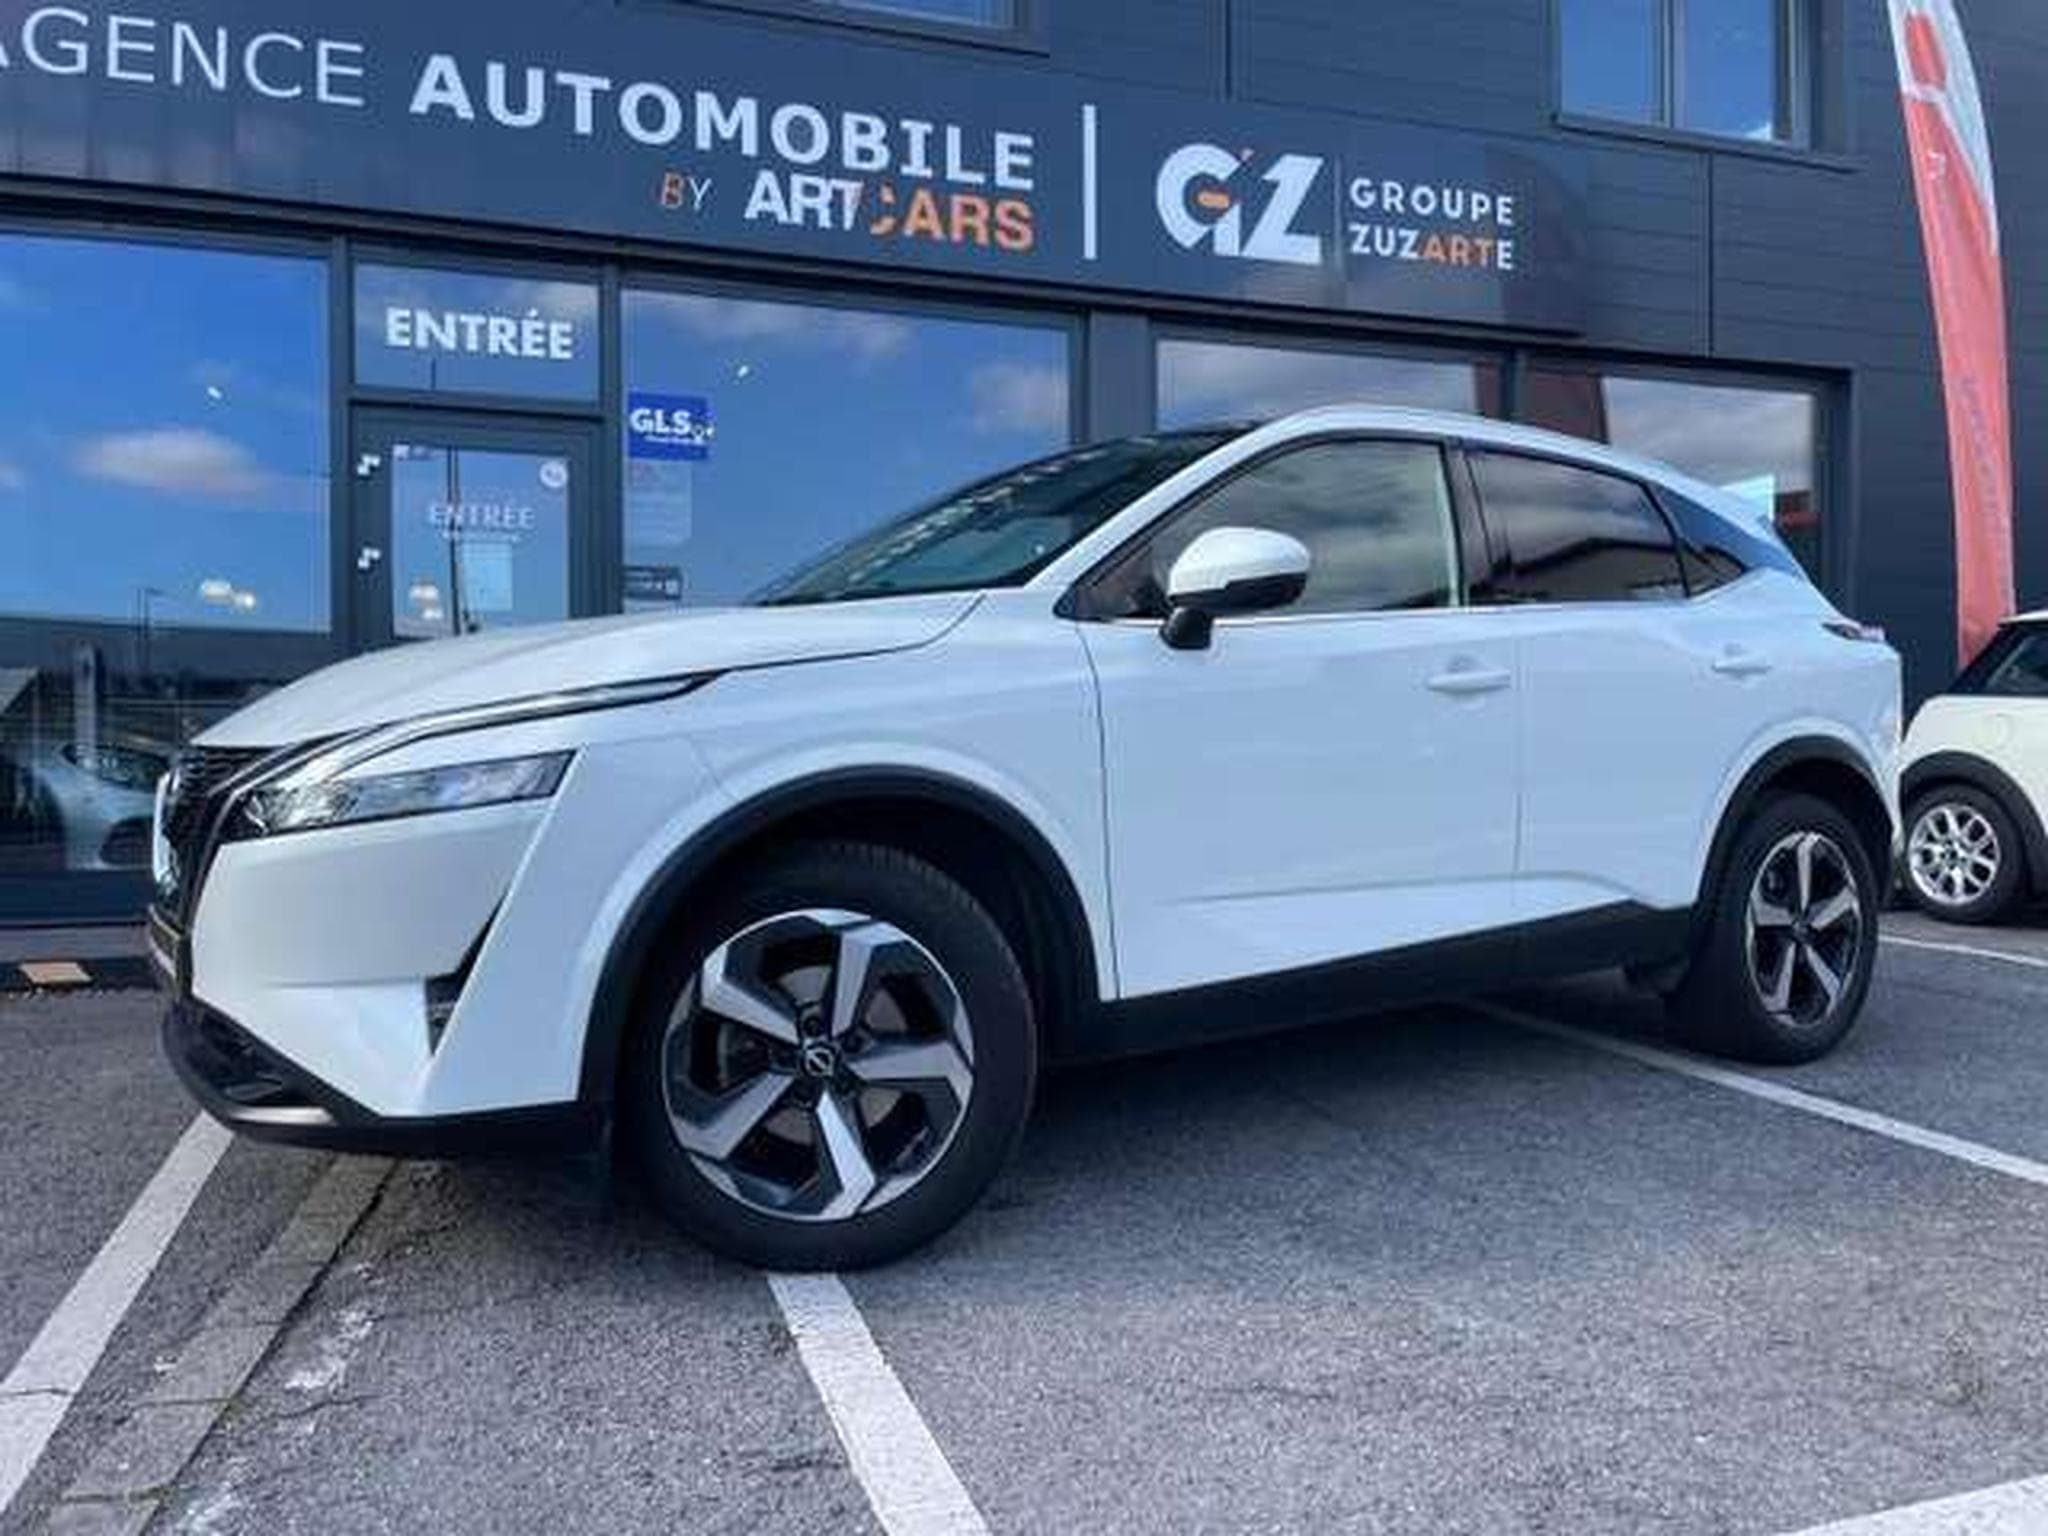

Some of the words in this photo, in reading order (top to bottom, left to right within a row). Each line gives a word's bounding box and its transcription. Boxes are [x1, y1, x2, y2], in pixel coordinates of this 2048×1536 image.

[409, 53, 1035, 191] AUTOMOBILE
[659, 172, 711, 211] BY
[1348, 177, 1515, 227] GROUPE
[1348, 223, 1516, 270] ZUZARTE
[385, 307, 574, 360] ENTRÉE
